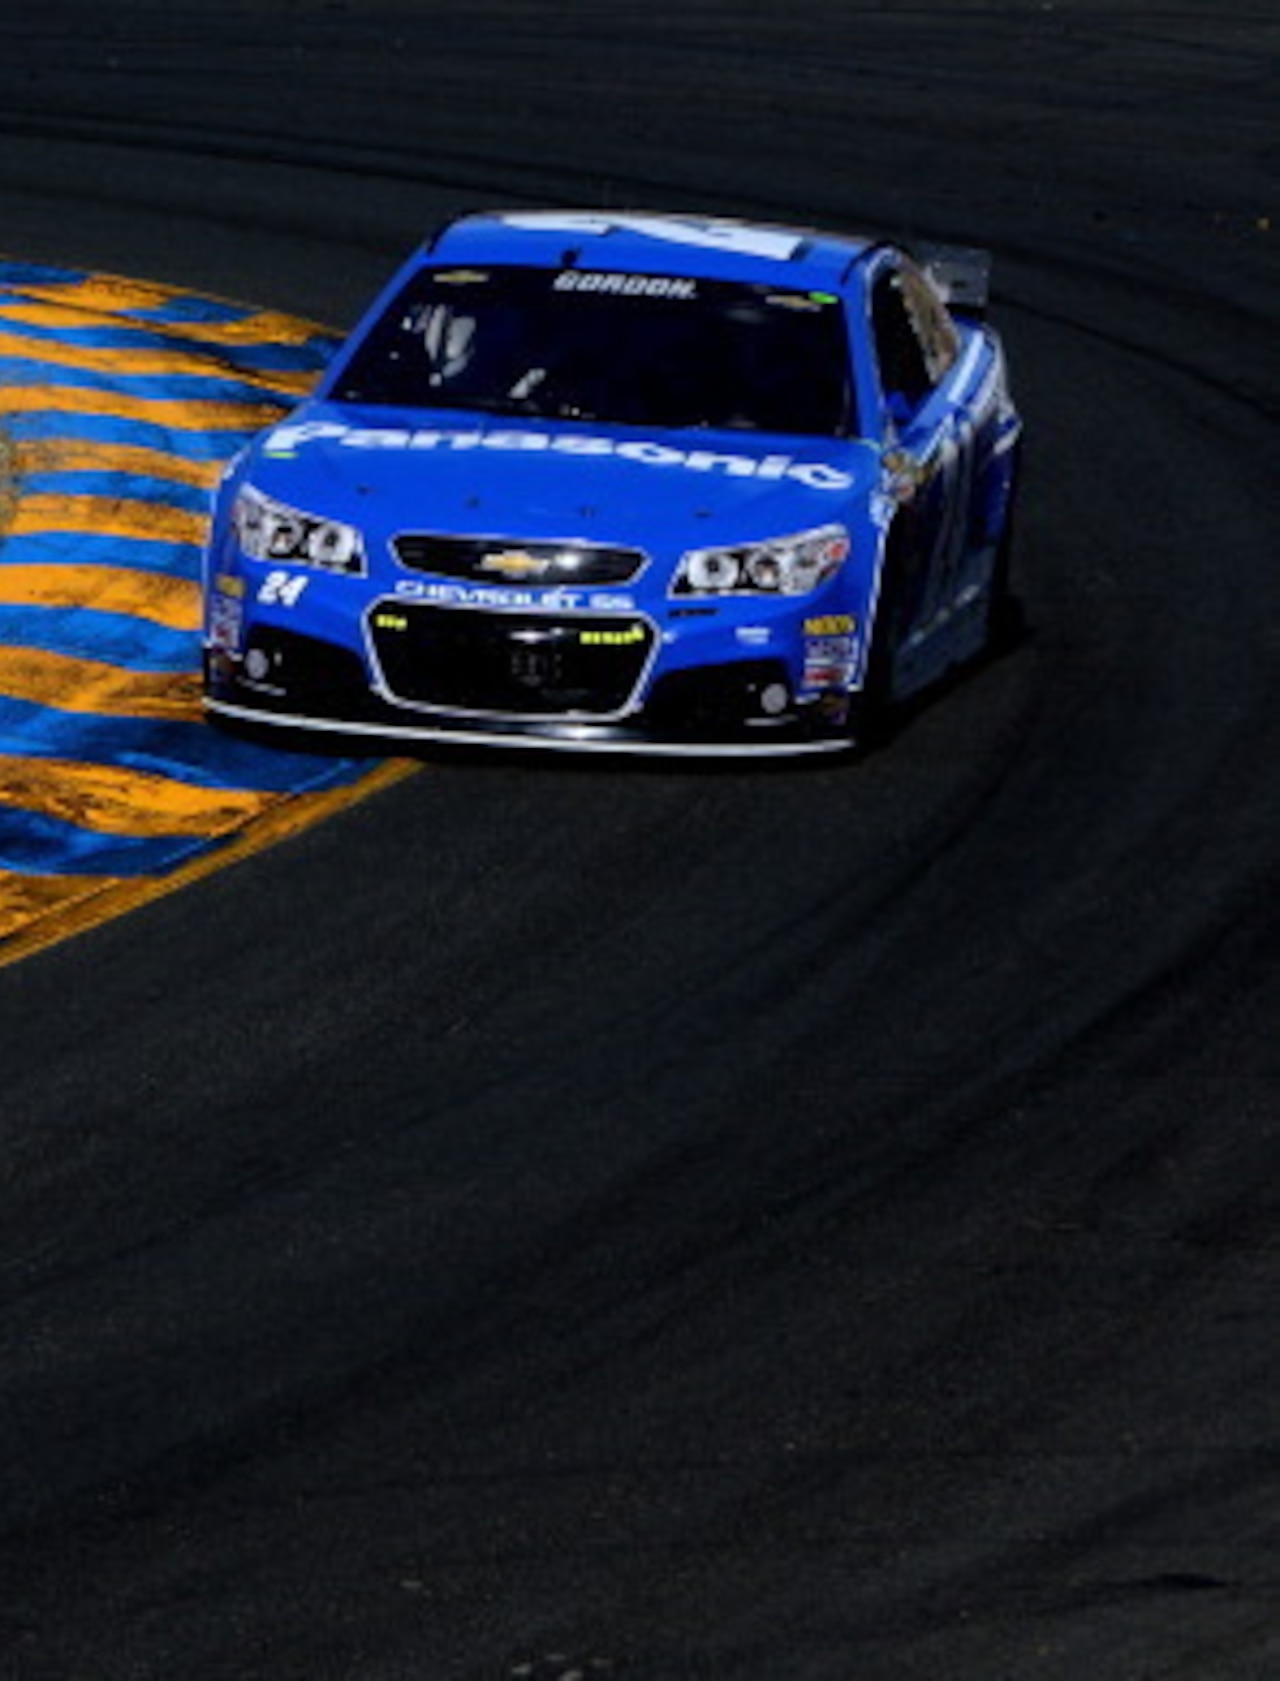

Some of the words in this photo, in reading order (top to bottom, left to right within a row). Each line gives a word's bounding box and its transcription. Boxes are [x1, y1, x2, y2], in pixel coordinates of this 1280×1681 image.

[554, 270, 696, 299] GORDON
[264, 421, 853, 490] Panasonic
[257, 571, 308, 607] 24
[394, 580, 583, 609] CHEVROLET
